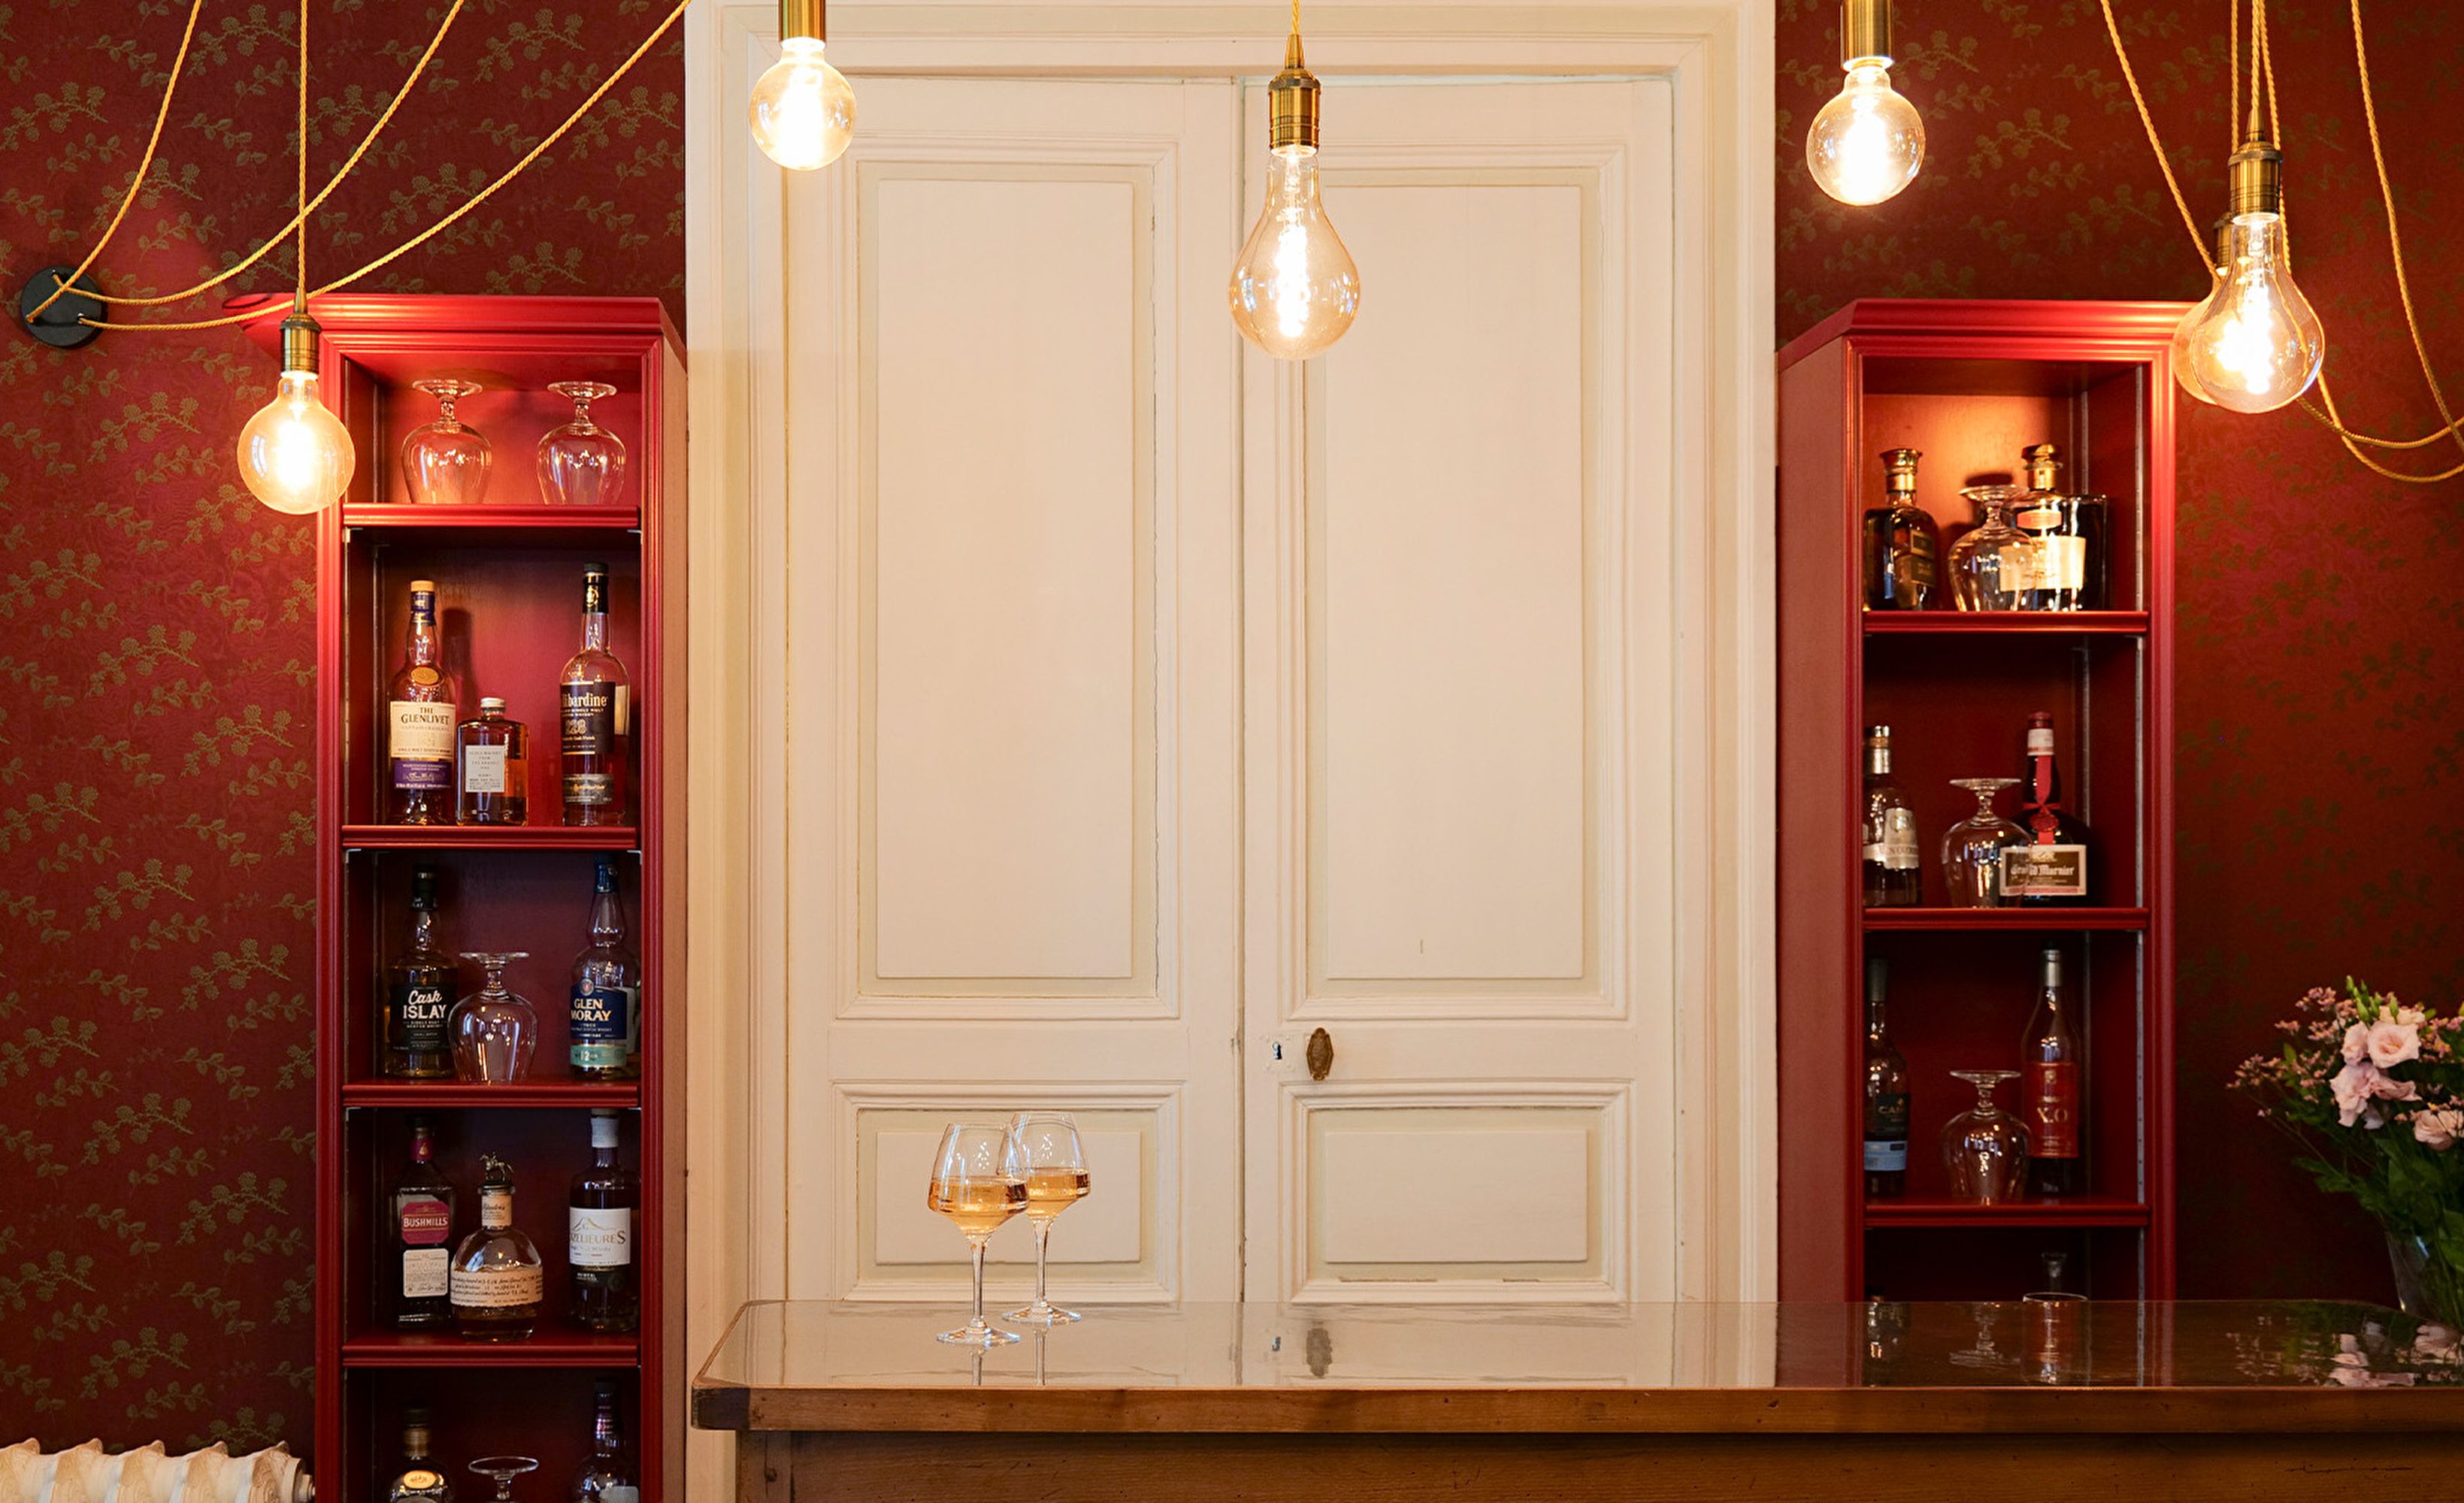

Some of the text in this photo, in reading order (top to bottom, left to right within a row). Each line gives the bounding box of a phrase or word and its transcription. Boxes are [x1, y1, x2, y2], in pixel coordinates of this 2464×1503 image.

[401, 713, 450, 726] GLENLIVET
[408, 990, 442, 1005] Cask
[574, 998, 604, 1009] GLEN
[403, 1005, 447, 1019] ISLAY
[403, 1217, 448, 1228] BUSHMILLS
